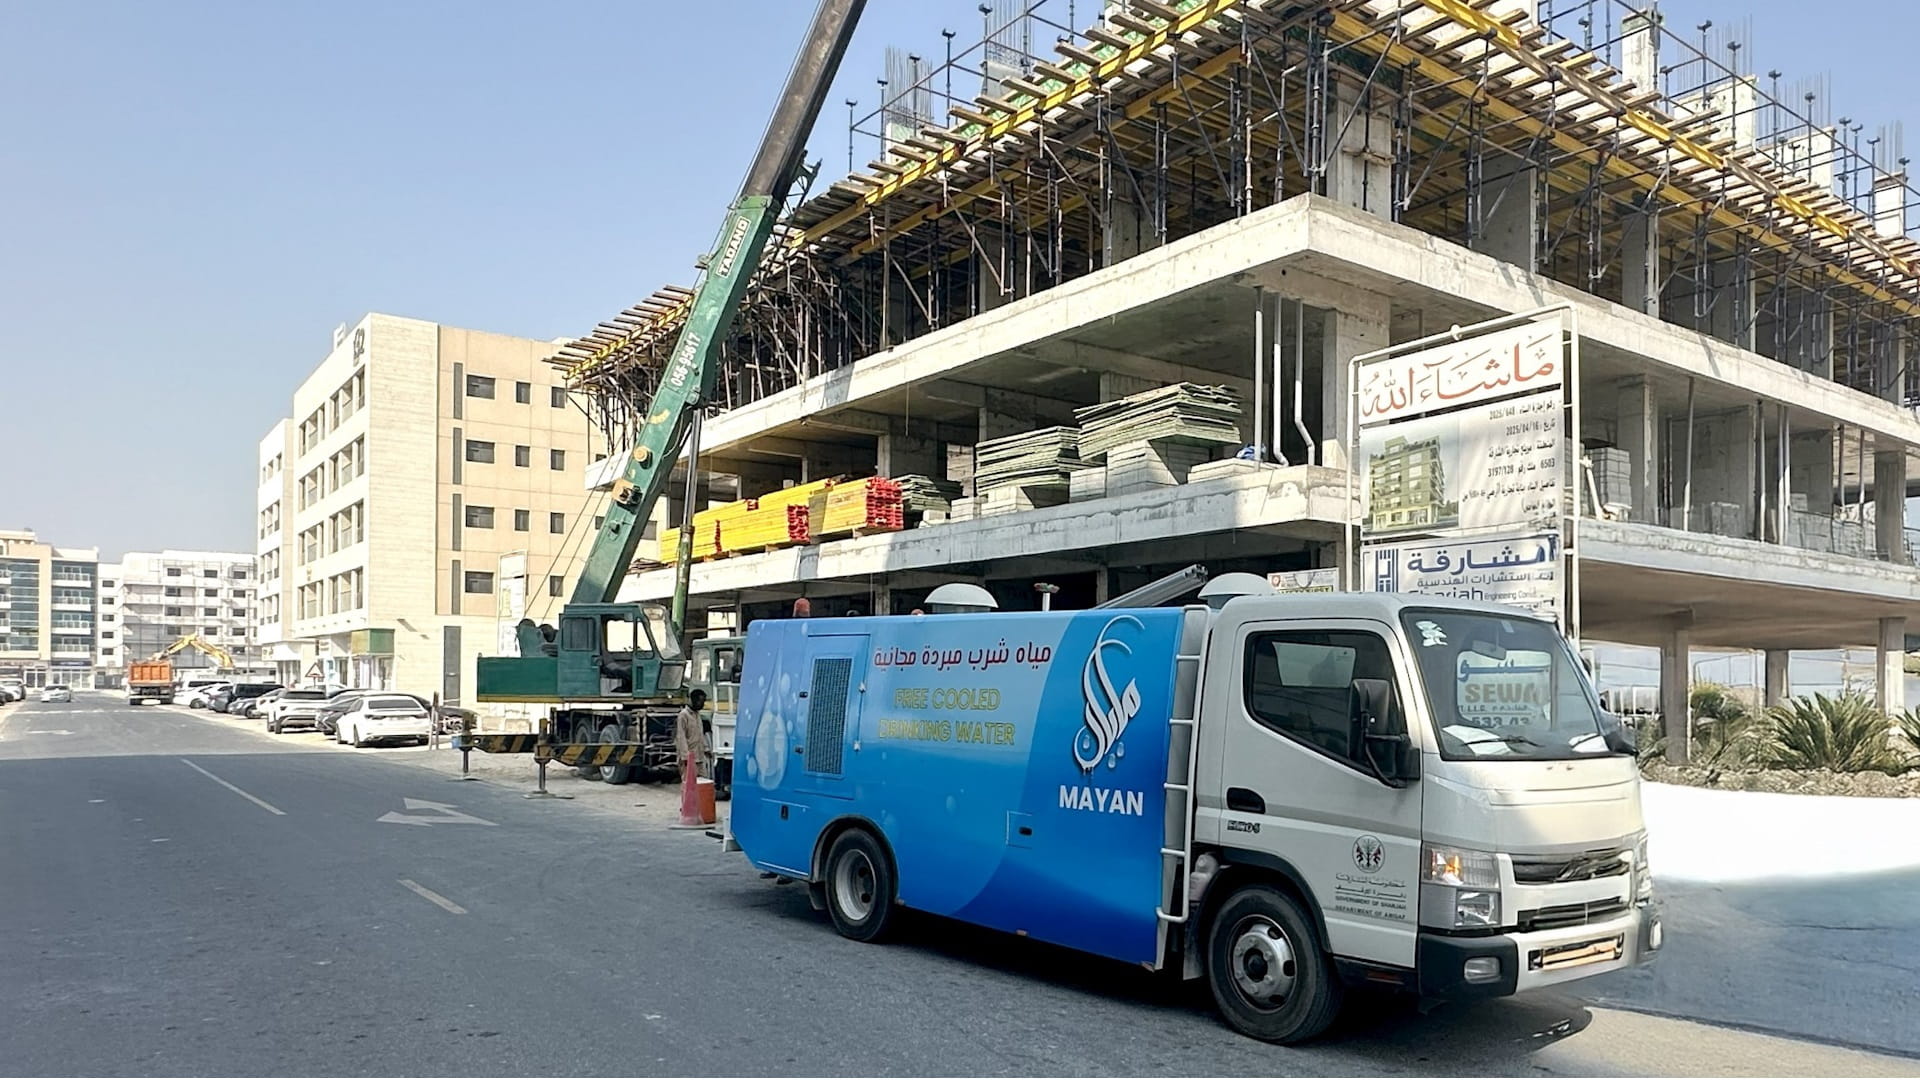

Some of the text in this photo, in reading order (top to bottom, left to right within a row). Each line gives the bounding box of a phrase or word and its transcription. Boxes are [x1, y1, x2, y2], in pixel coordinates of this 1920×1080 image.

[719, 219, 749, 275] TADANO
[874, 638, 1051, 672] مياه شرب مبردة مجانية
[894, 688, 1000, 710] FREE COOLED
[878, 718, 1016, 746] DRINKING WATER
[1059, 785, 1144, 816] MAYAN
